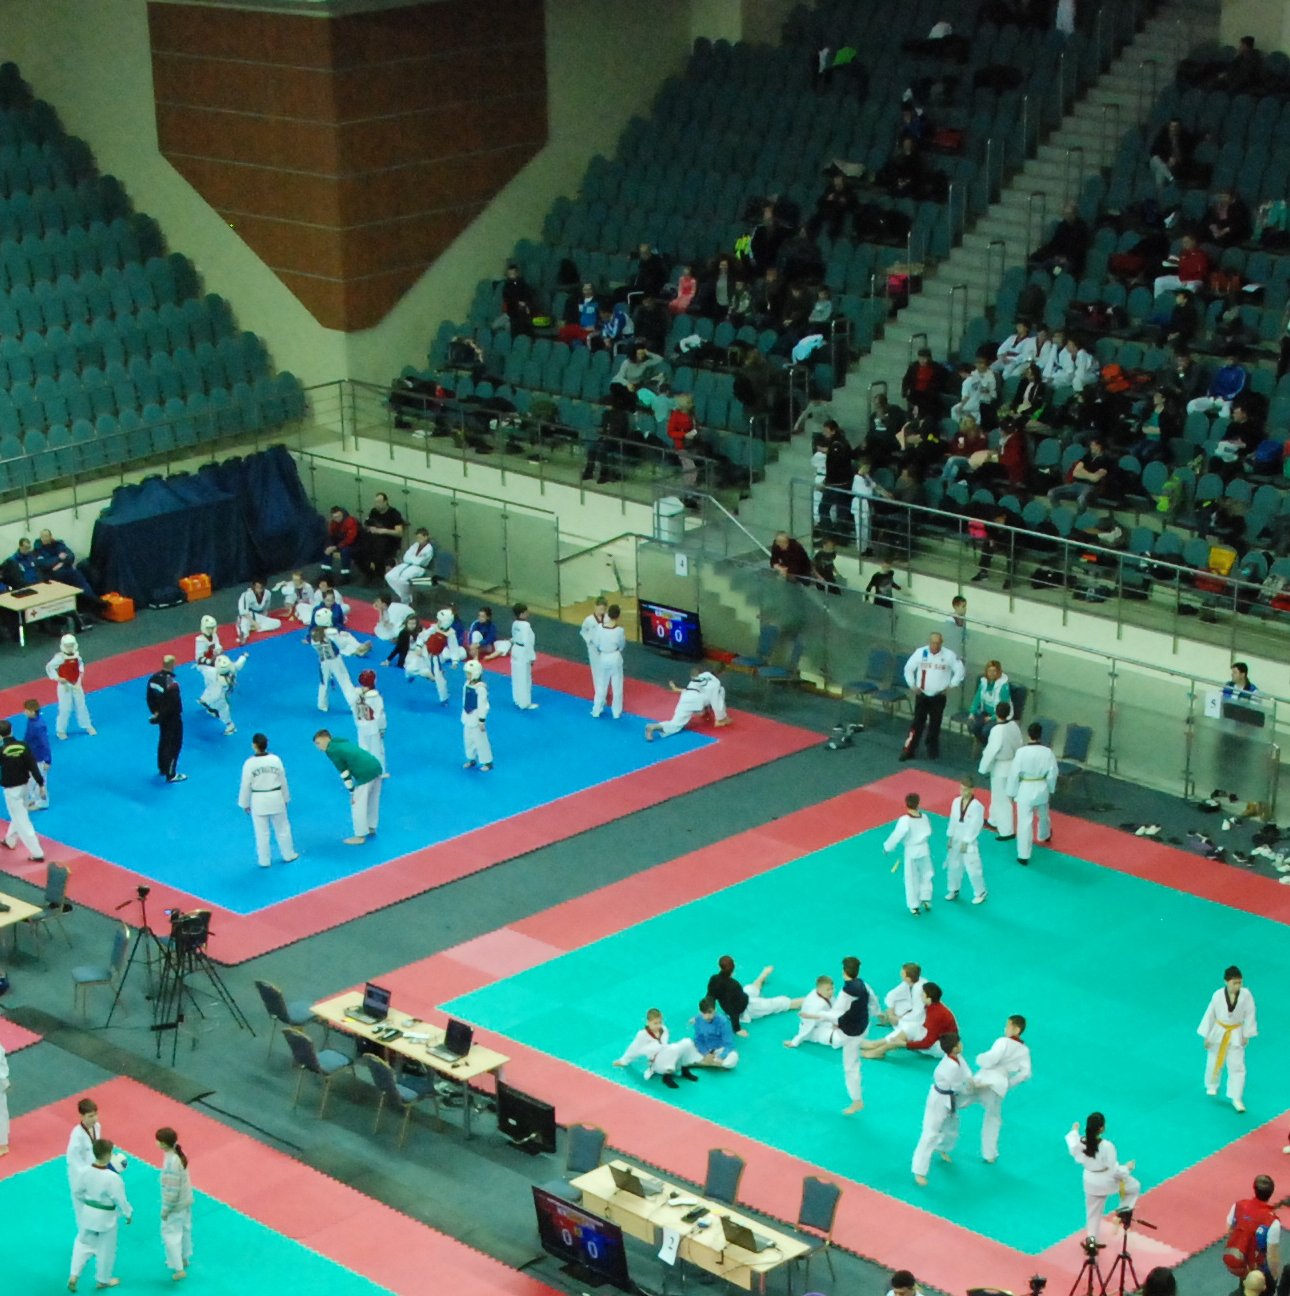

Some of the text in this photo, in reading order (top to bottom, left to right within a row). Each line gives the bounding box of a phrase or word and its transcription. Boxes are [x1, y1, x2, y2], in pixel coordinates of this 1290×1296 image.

[657, 625, 682, 642] 0 0
[562, 1229, 598, 1258] 0 0
